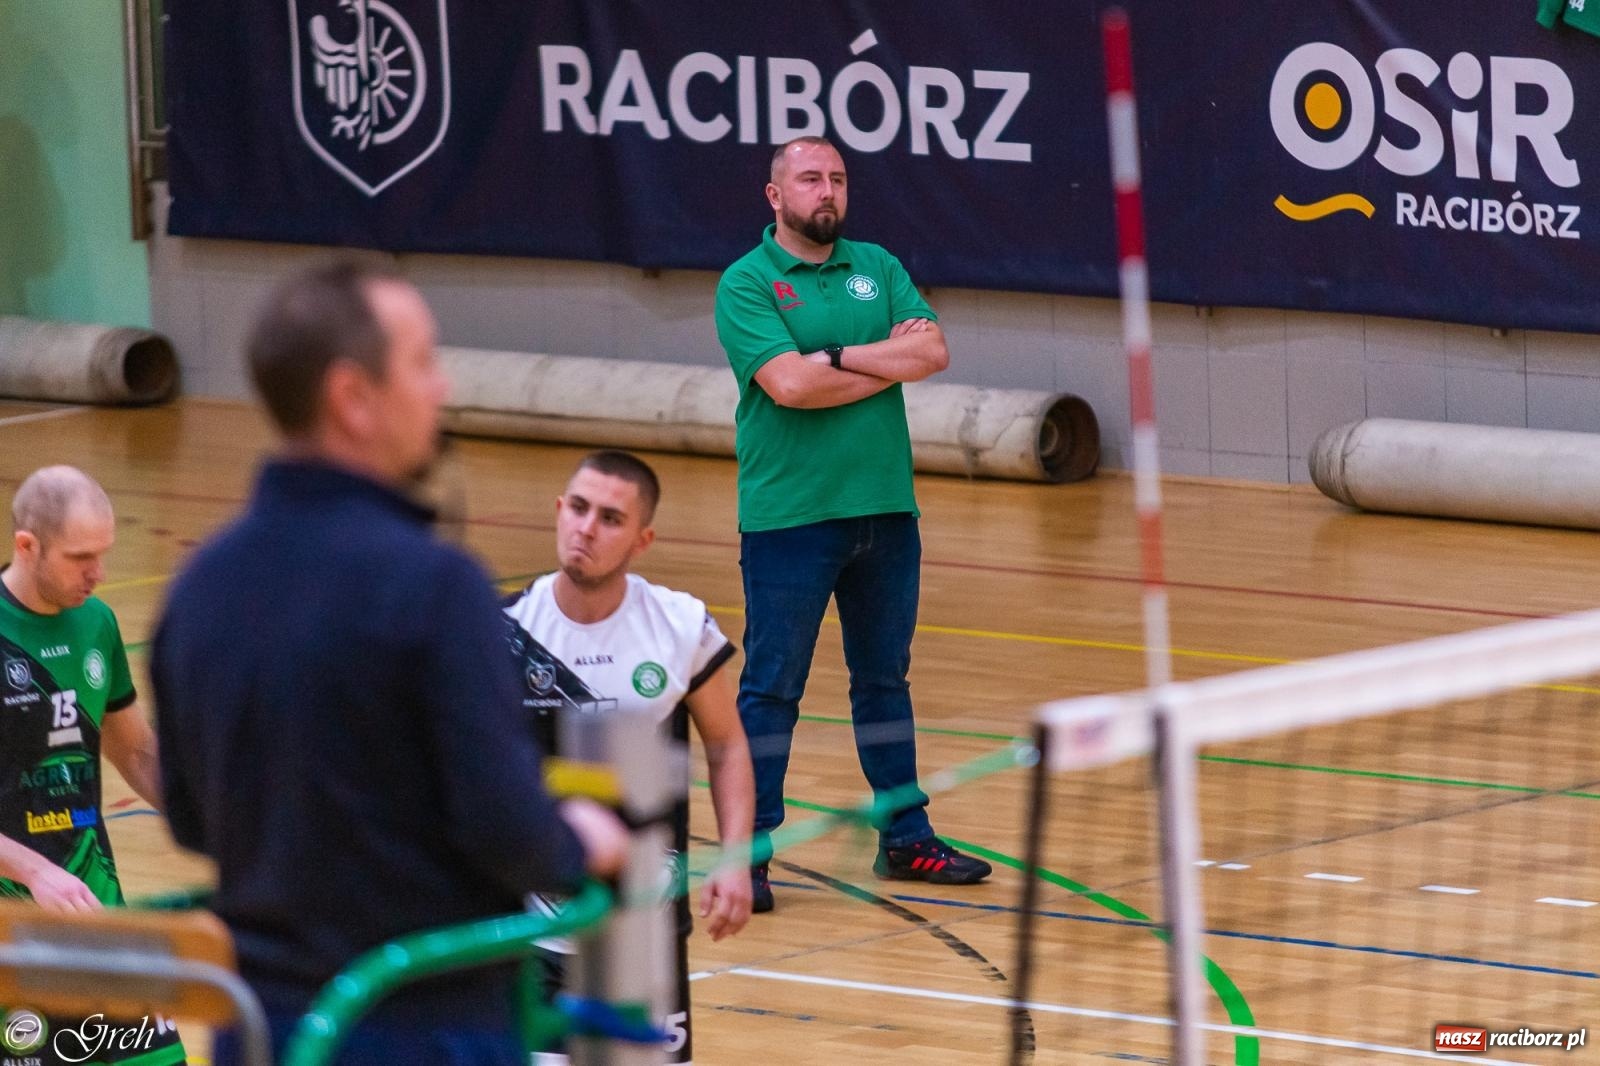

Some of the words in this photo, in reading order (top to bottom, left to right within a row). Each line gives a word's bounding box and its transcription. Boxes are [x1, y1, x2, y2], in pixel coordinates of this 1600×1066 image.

[538, 28, 1032, 162] RACIBÓRZ
[1396, 190, 1581, 239] RACIBÓRZ
[40, 645, 71, 658] ALLSIX
[574, 654, 614, 666] ALLSIX
[51, 688, 78, 728] 13
